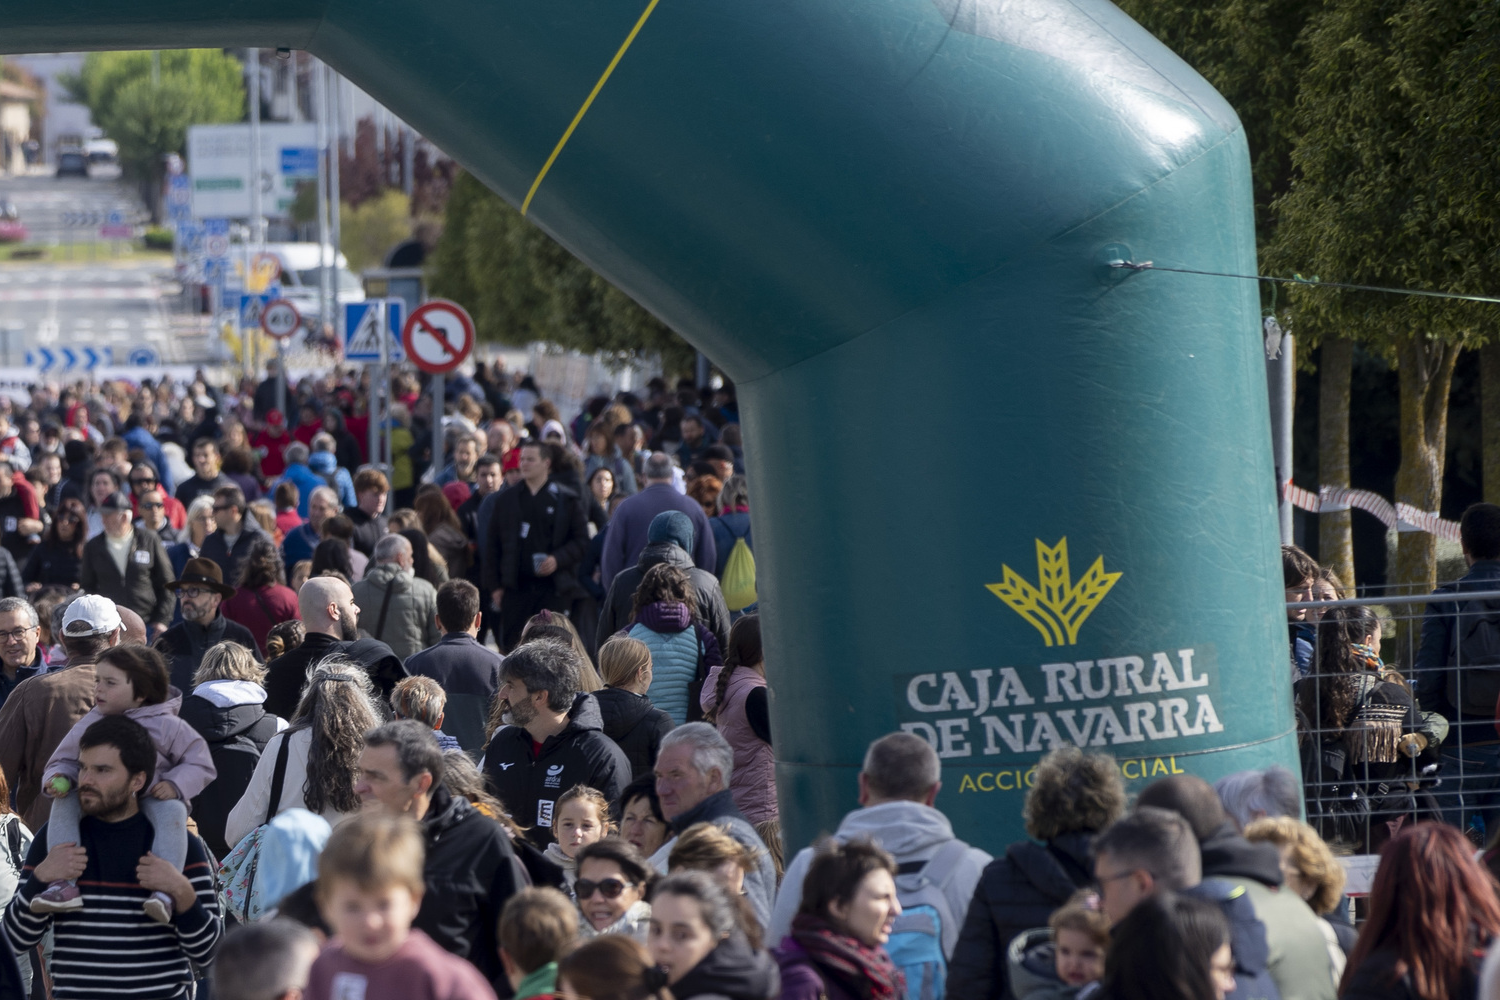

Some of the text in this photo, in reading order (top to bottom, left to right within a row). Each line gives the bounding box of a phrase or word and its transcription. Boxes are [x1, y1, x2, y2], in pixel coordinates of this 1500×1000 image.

[907, 649, 1208, 716] CAJA RURAL
[901, 694, 1224, 759] DE NAVARRA
[1122, 755, 1184, 779] CIAL
